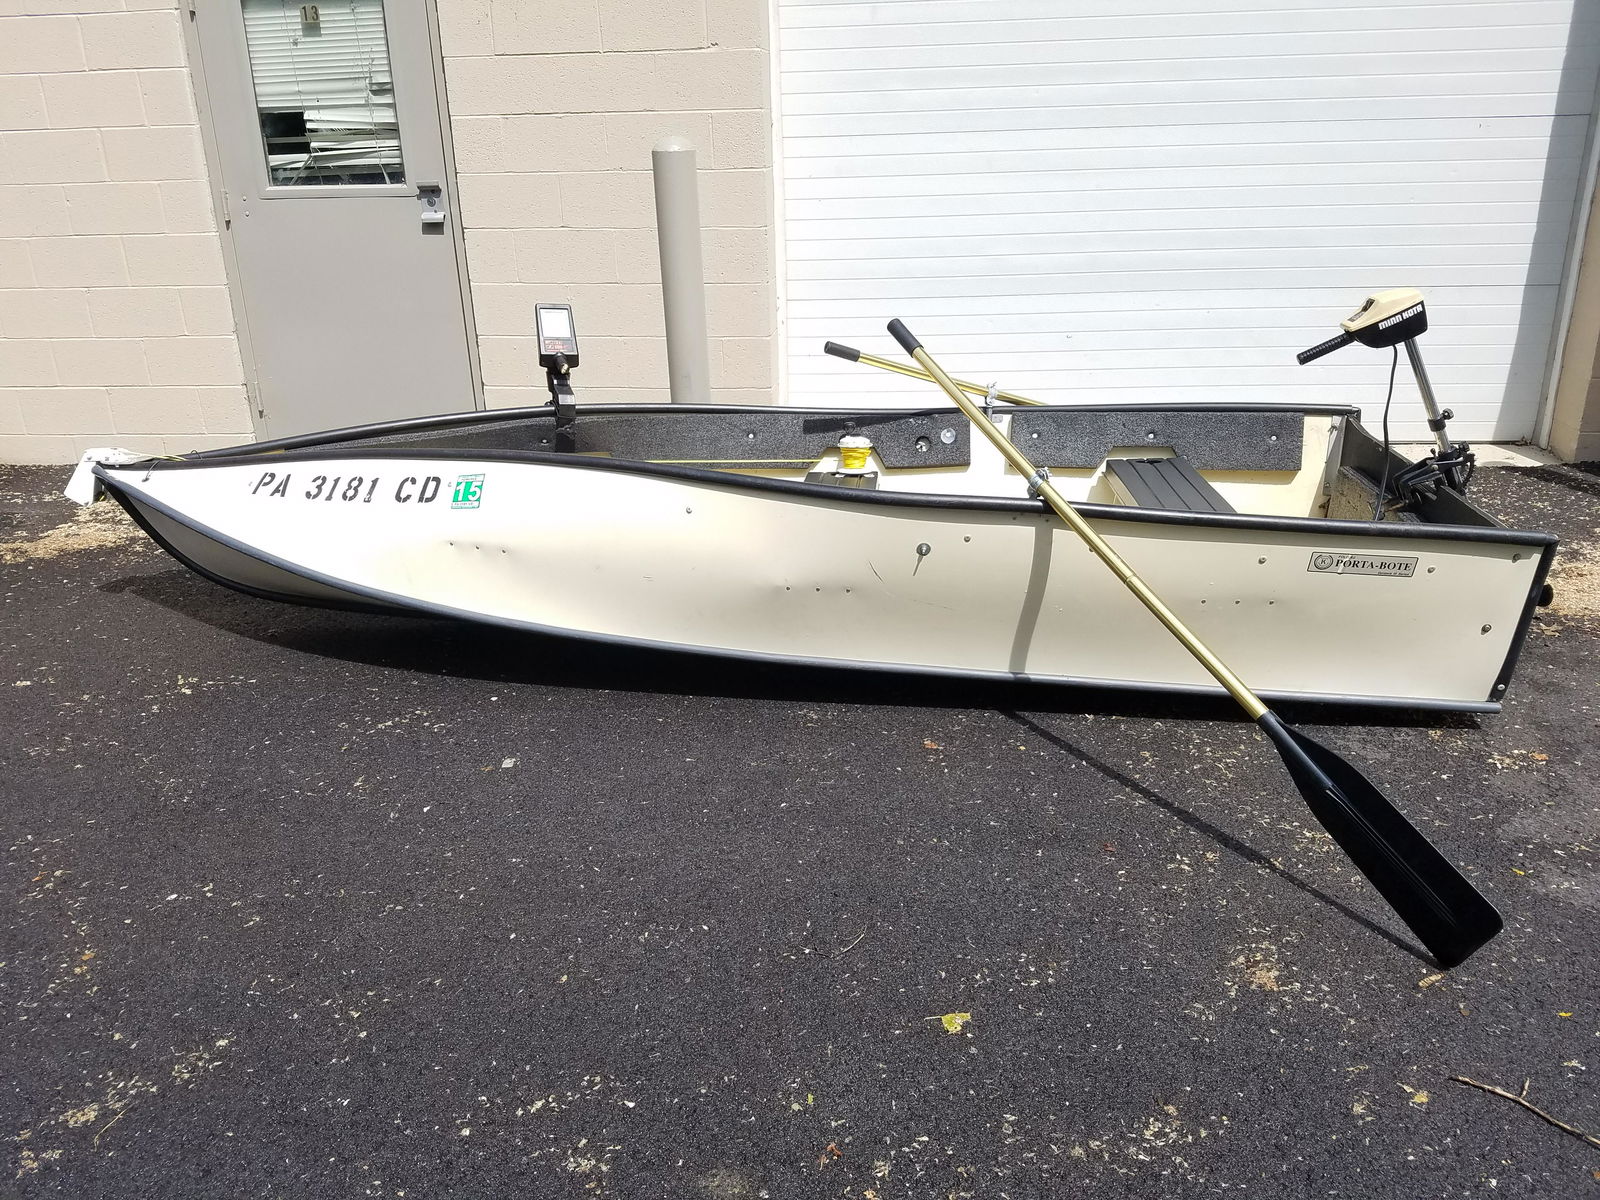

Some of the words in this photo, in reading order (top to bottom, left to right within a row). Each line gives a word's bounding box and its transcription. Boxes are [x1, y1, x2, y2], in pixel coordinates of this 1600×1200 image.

[301, 5, 319, 21] 13
[1402, 304, 1423, 320] KOTA
[252, 472, 291, 497] PA
[305, 475, 380, 503] 3181
[394, 476, 442, 503] CD
[455, 480, 481, 501] 15
[1335, 559, 1413, 571] PORTA-BOTE
